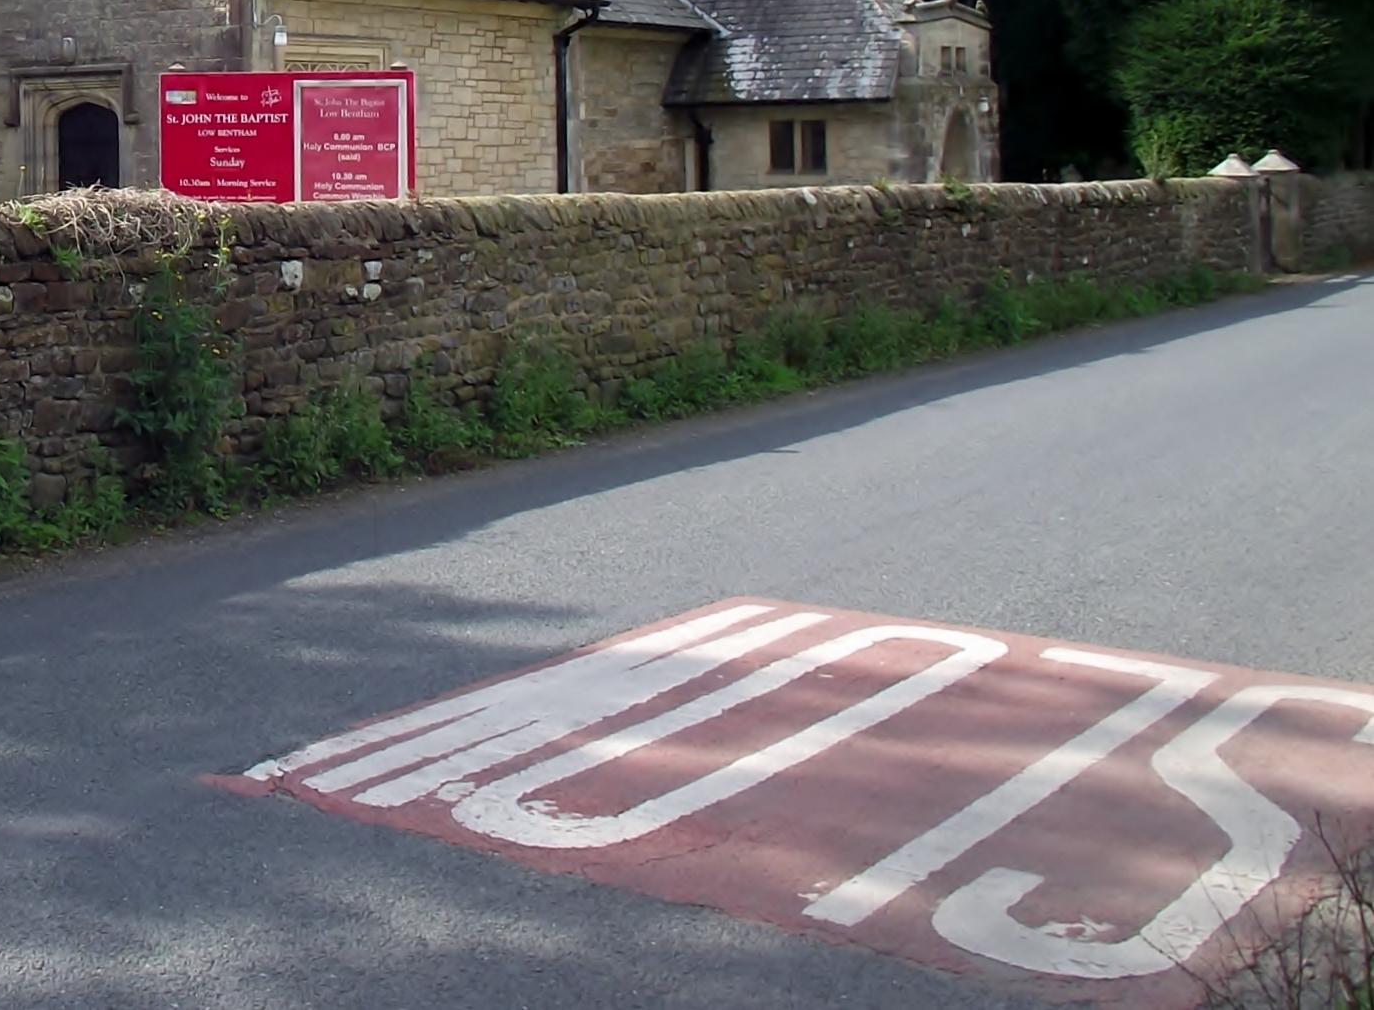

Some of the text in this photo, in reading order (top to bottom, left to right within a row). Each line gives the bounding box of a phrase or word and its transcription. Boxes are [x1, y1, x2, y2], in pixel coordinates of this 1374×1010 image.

[205, 93, 238, 101] Welcome
[345, 98, 357, 106] The
[360, 98, 386, 107] Baptist
[319, 108, 380, 118] Low Bentham
[166, 113, 289, 125] St. JOHN THE BAPTIST
[198, 129, 257, 137] LOW BENTHAM
[303, 143, 396, 152] Holy Communion BCP
[337, 153, 361, 162] (said)
[209, 156, 245, 169] Sunday
[331, 172, 353, 180] 10.30
[216, 179, 248, 188] Morning
[249, 179, 277, 187] Service
[314, 182, 384, 191] Holy Communion
